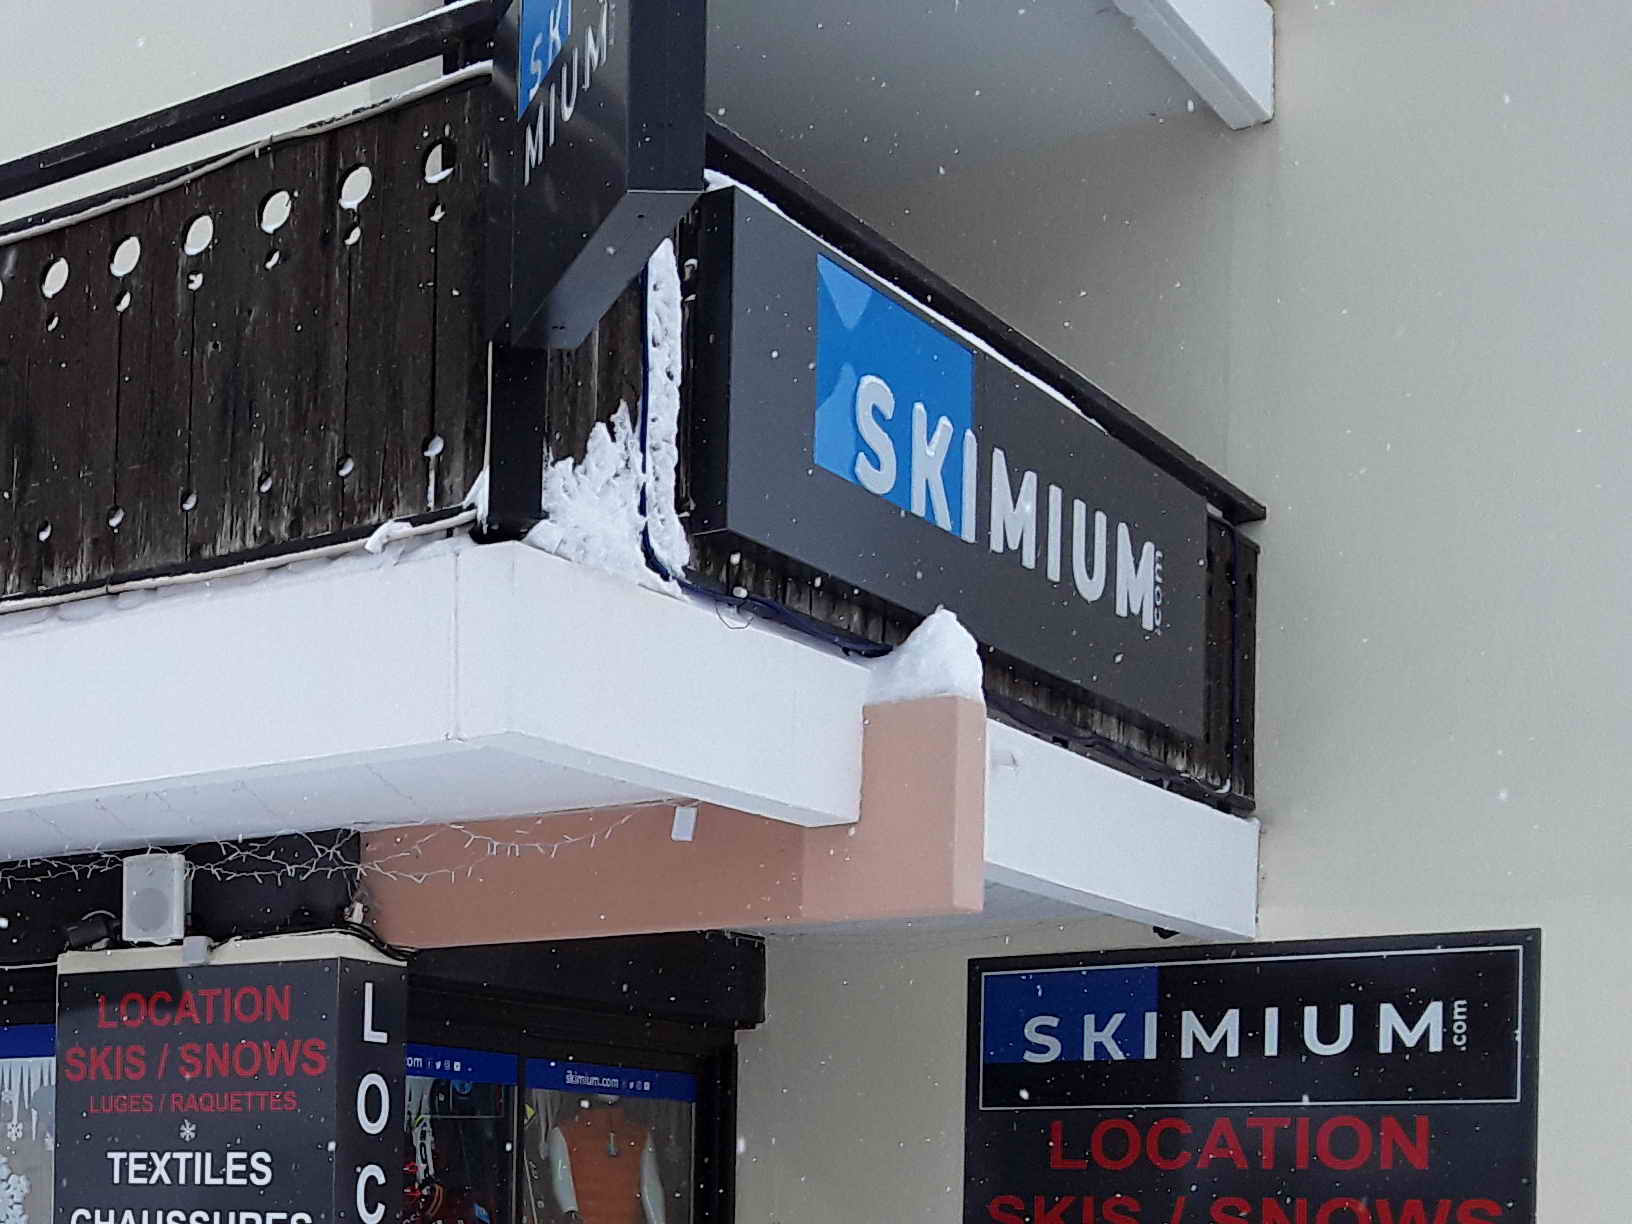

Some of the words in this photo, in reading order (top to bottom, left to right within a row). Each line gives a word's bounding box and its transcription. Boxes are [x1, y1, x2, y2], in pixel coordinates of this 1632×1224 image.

[855, 375, 1155, 631] SKIMIUM
[97, 985, 293, 1029] LOCATION
[1022, 1000, 1443, 1064] SKIMIUM
[1450, 999, 1468, 1051] .com
[65, 1045, 145, 1082] SKIS
[179, 1038, 328, 1080] SNOWS
[90, 1094, 153, 1113] LUGES
[170, 1091, 297, 1113] RAQUETTES
[1049, 1115, 1430, 1170] LOCATION
[107, 1151, 272, 1186] TEXTILES
